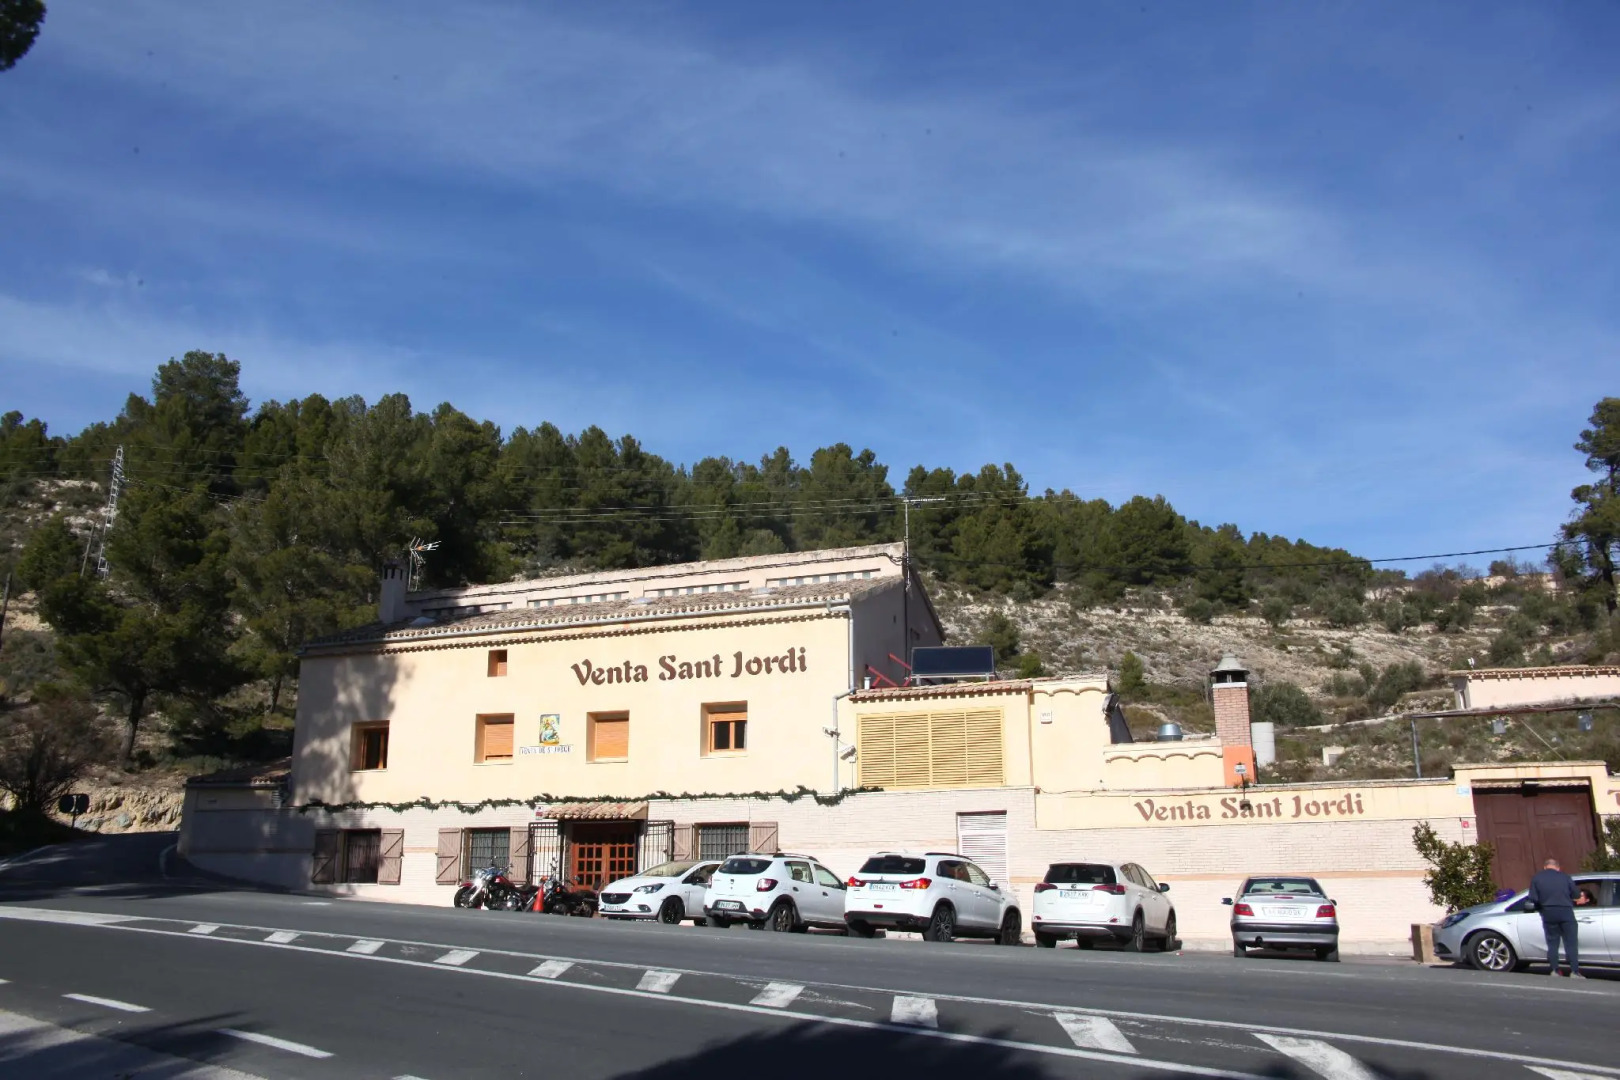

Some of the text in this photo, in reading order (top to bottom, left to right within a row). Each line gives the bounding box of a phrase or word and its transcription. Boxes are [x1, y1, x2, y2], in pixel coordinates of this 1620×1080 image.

[571, 647, 808, 686] Venta Sant Jordi
[1134, 793, 1364, 822] Venta Sant Jordi
